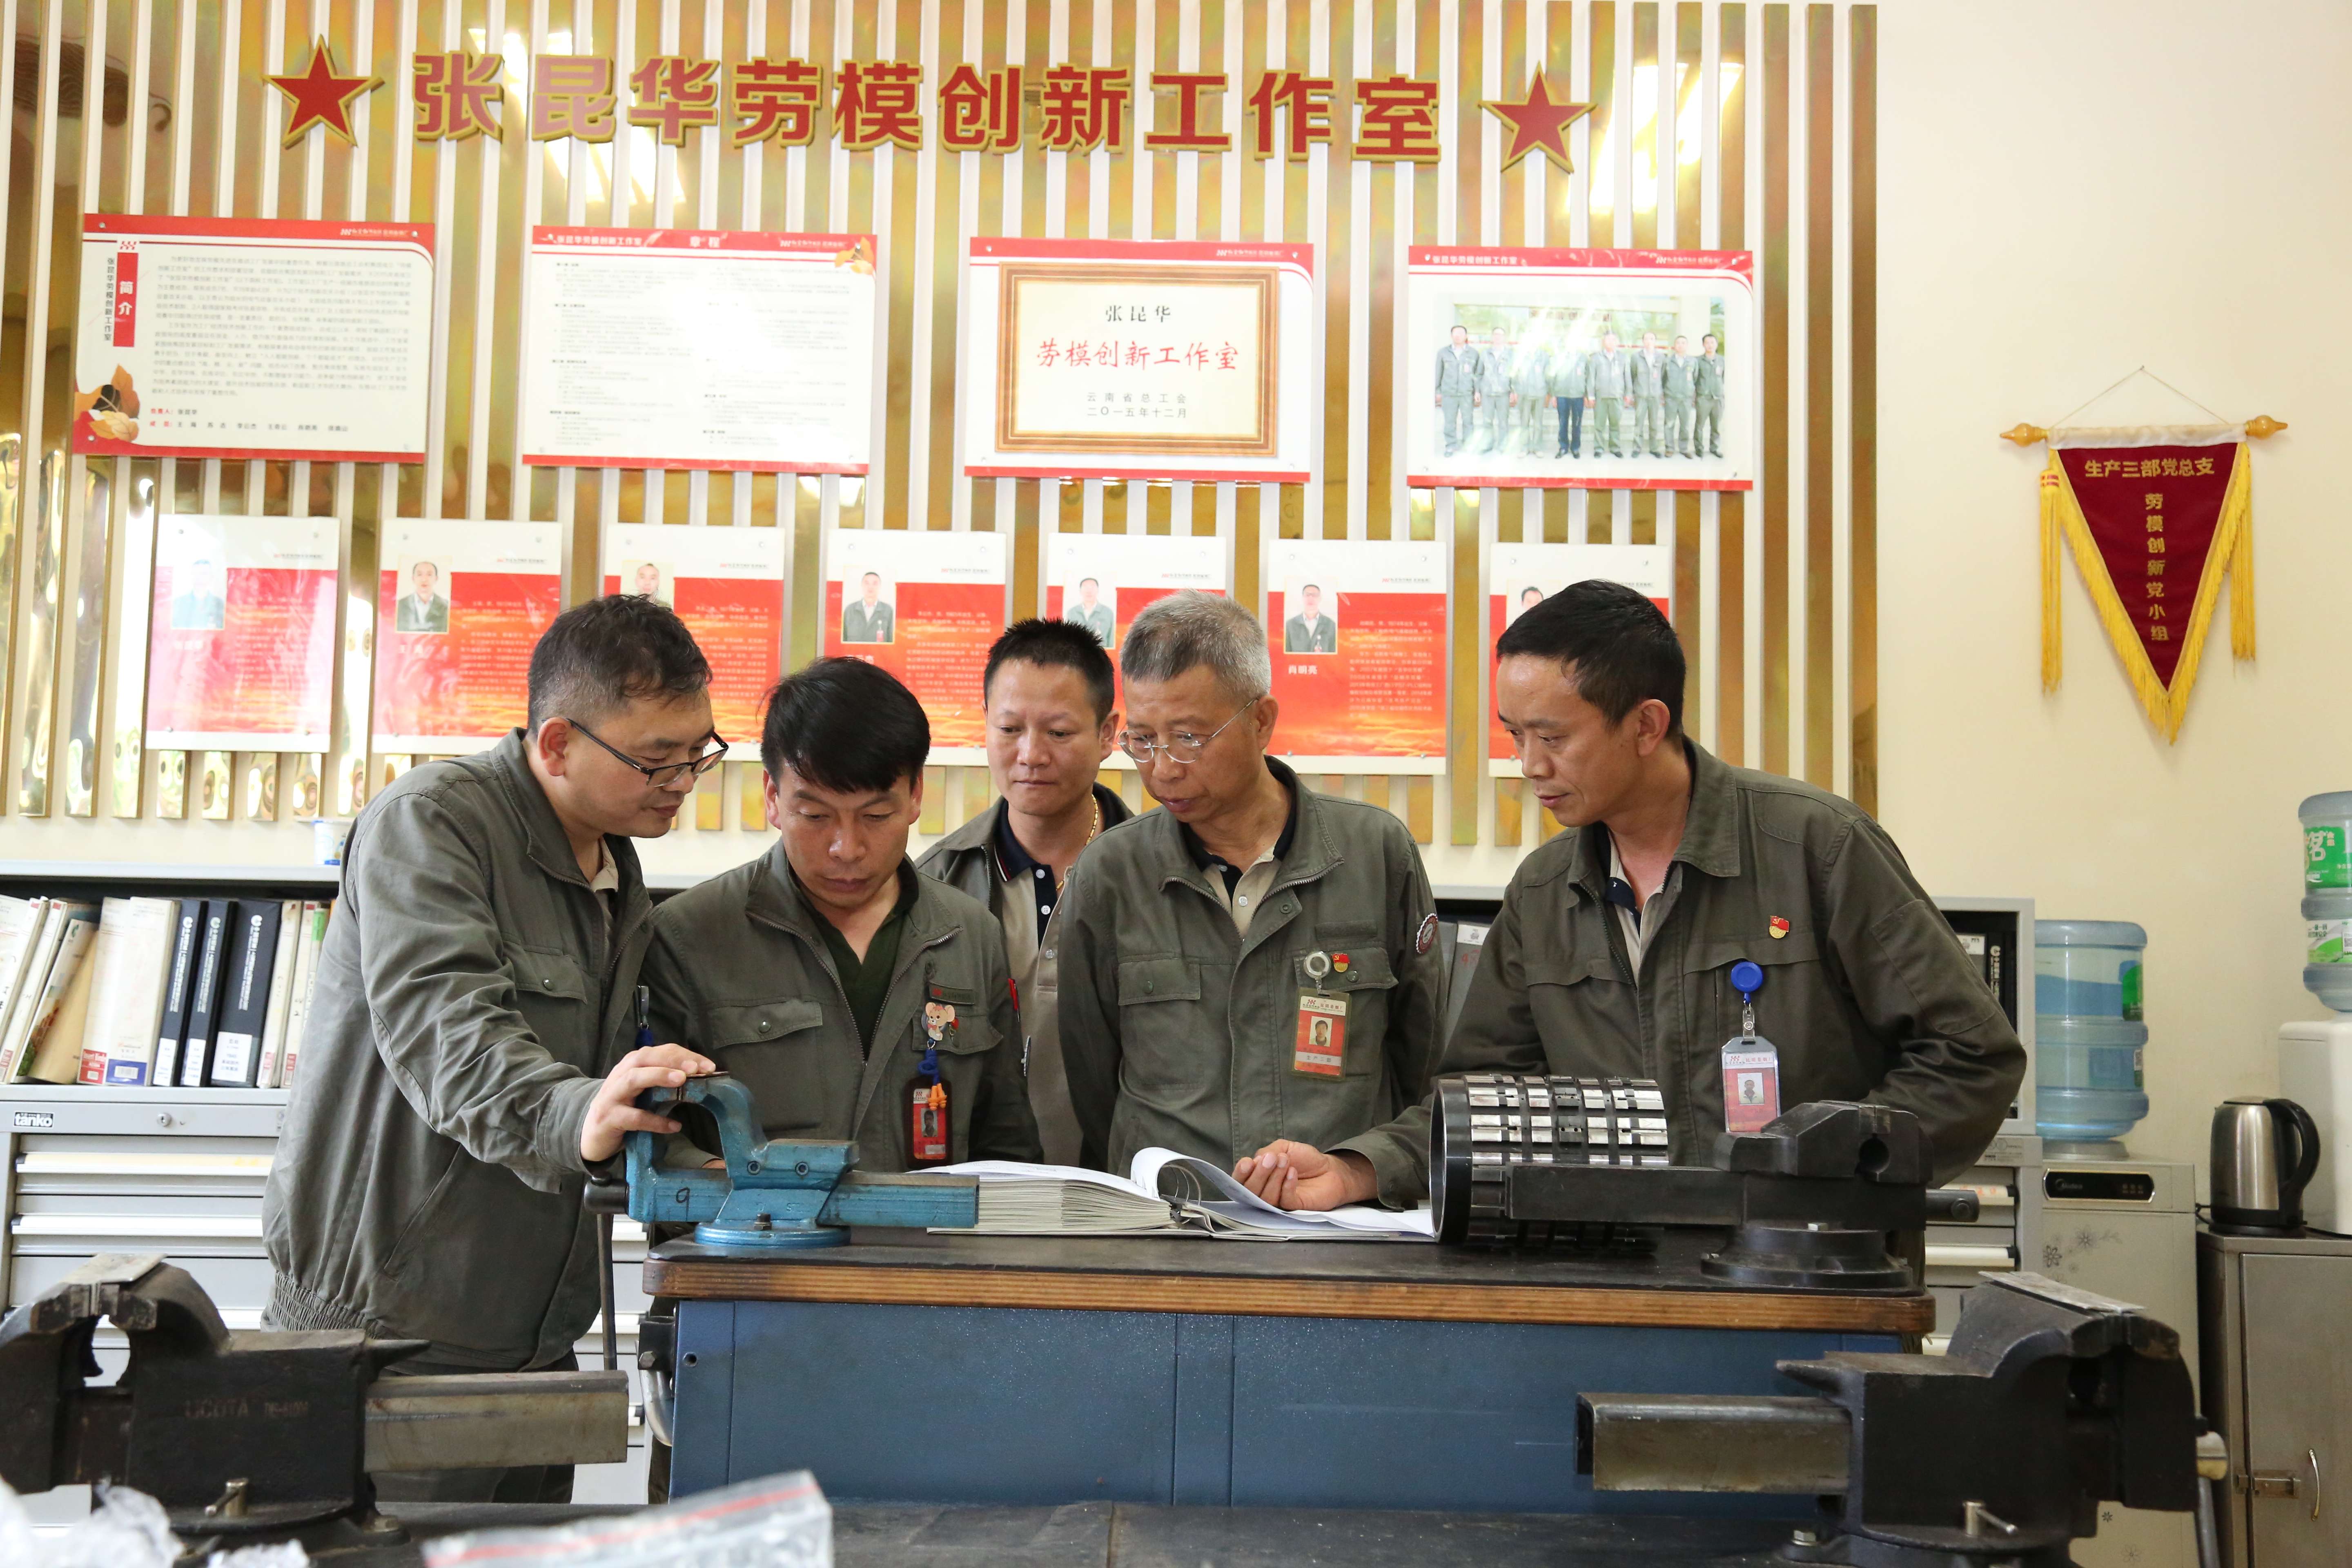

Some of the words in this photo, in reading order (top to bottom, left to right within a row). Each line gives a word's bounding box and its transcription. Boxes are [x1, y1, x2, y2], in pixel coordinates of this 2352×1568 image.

[413, 51, 1441, 162] 张昆华劳模创新工作室
[118, 280, 134, 315] 简介
[1105, 305, 1172, 323] 张昆华
[1036, 337, 1239, 371] 劳模创新工作室
[1087, 392, 1187, 404] 云南省总工会
[2084, 457, 2215, 478] 生产三部党总支
[2144, 493, 2169, 641] 劳模创新党小组
[15, 1113, 53, 1127] tanko
